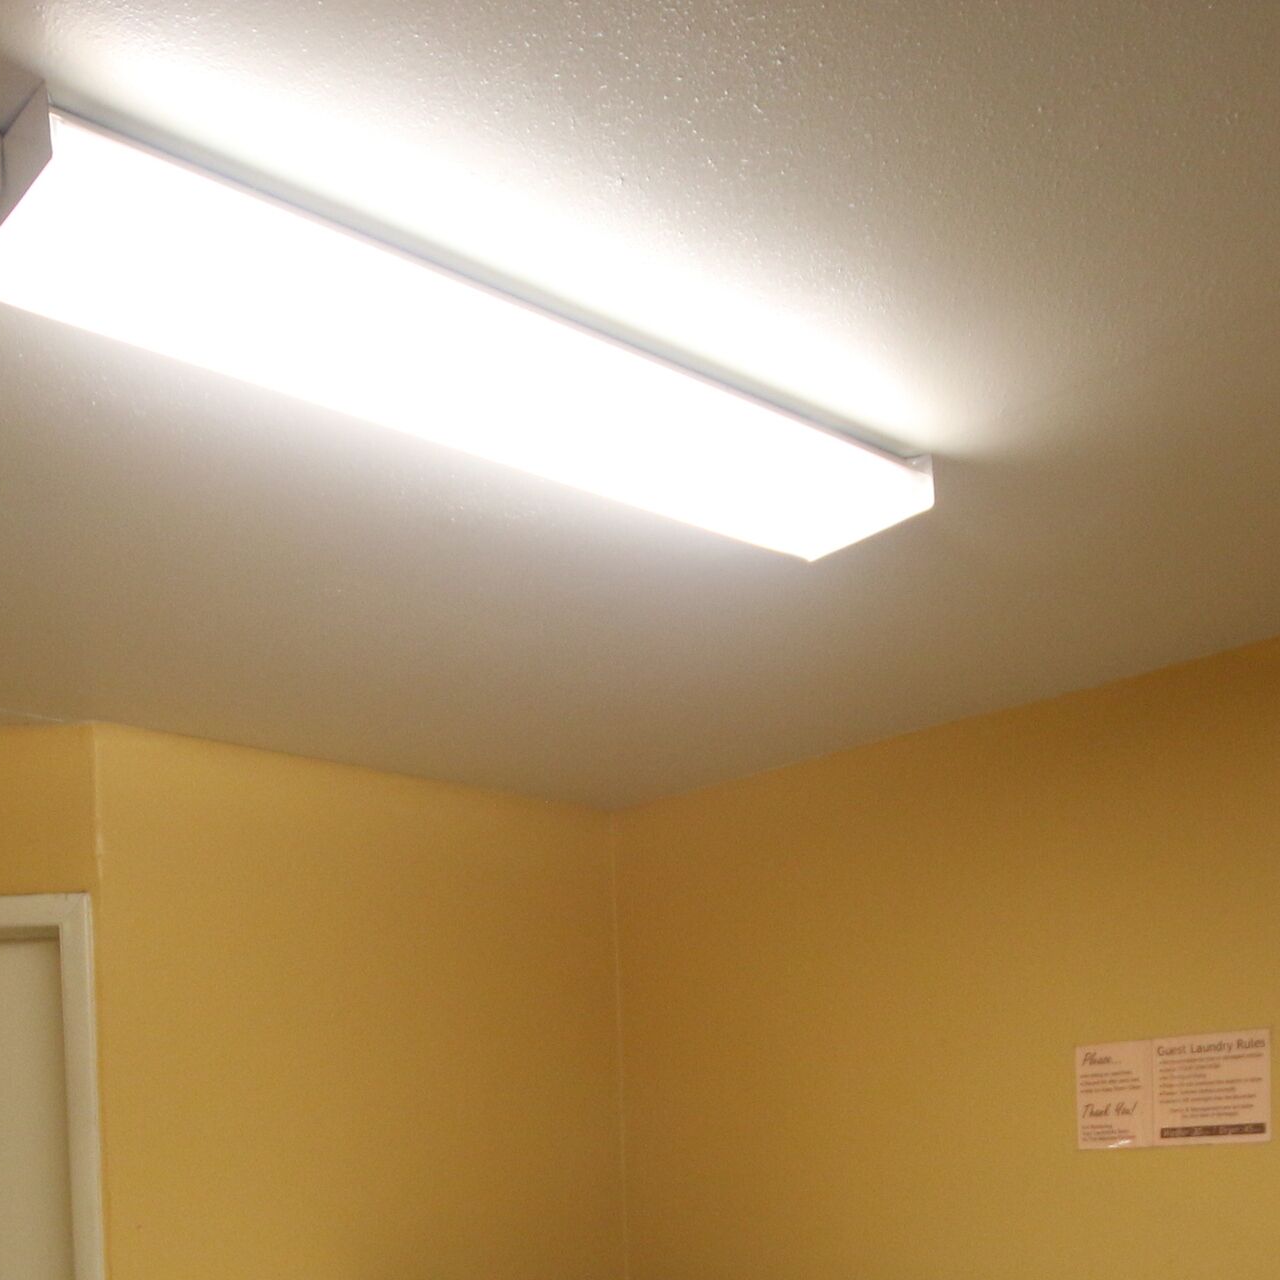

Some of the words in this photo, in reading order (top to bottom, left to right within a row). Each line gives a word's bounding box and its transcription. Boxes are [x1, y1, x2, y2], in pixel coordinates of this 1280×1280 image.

[1156, 1045, 1187, 1057] Guest
[1190, 1040, 1233, 1054] Laundry
[1236, 1037, 1266, 1049] Rules
[1081, 1102, 1112, 1119] Thank
